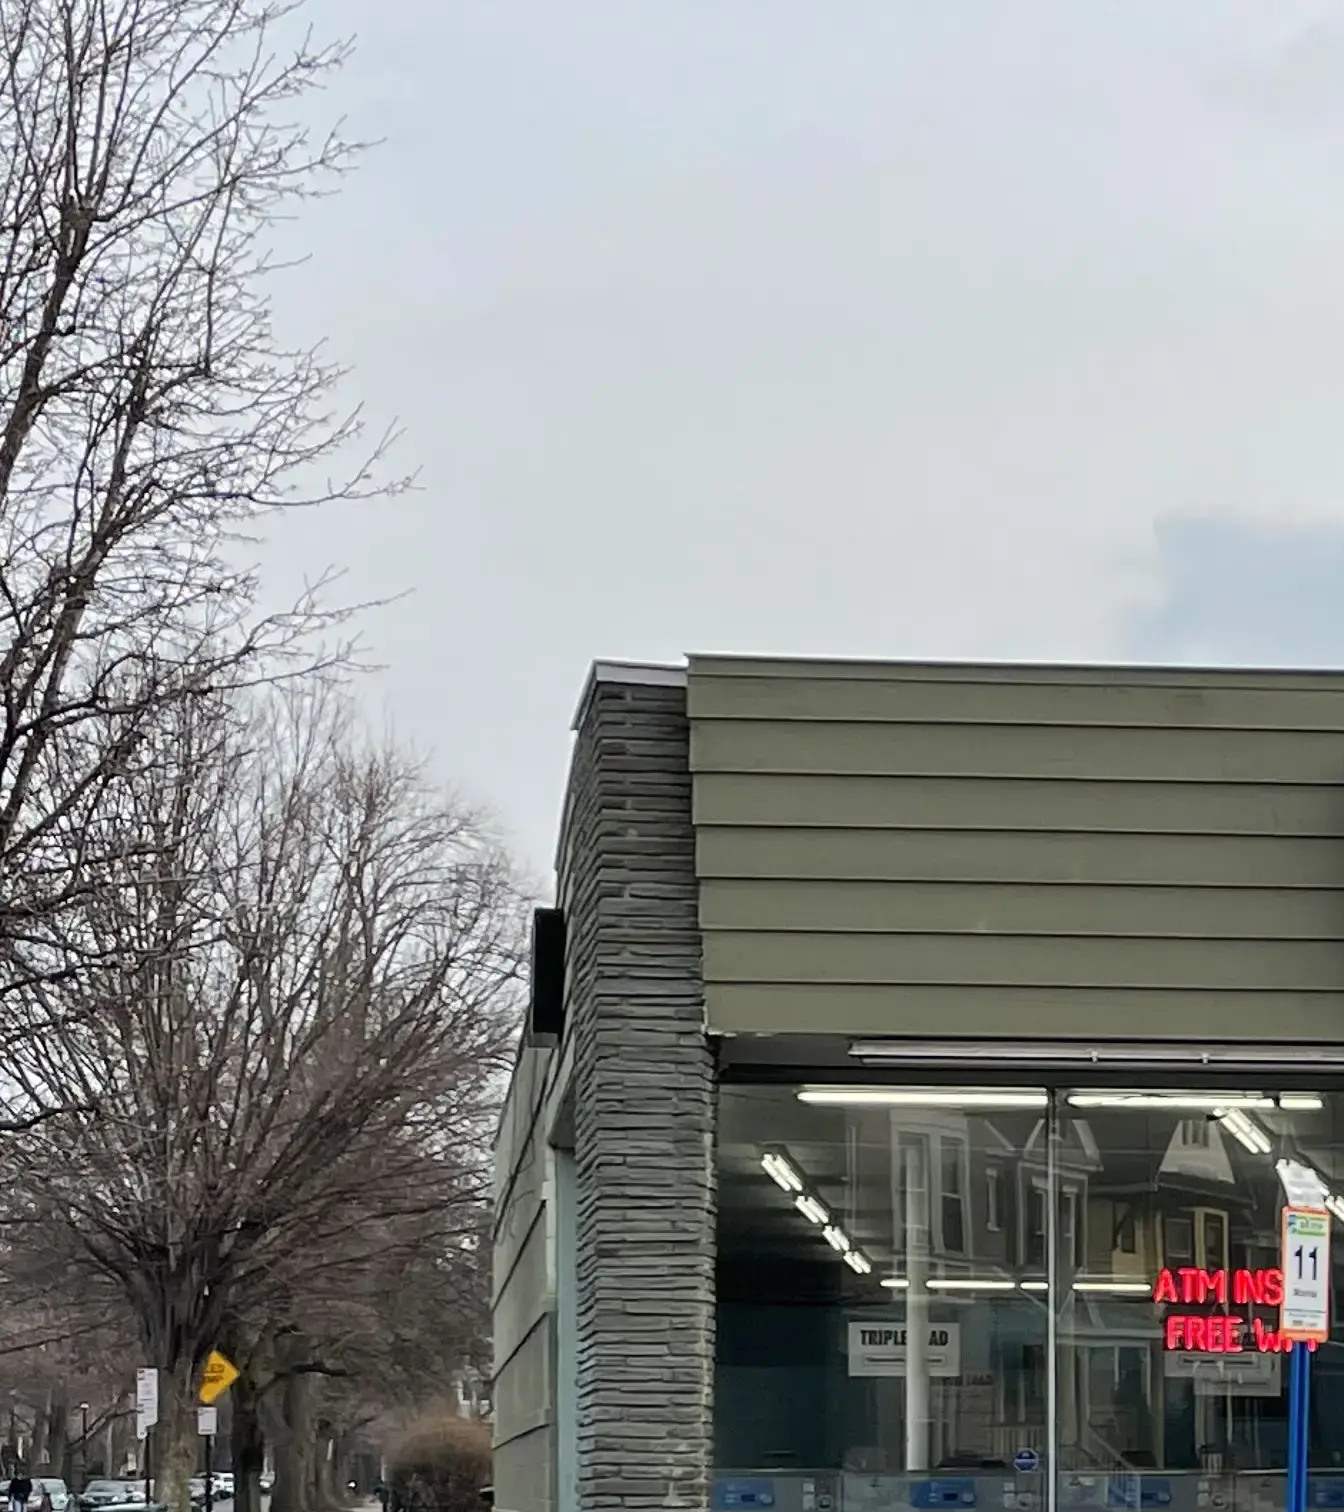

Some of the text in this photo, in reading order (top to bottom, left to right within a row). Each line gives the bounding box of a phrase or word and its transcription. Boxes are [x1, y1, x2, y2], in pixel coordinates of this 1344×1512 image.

[1294, 1245, 1318, 1281] 11
[1154, 1268, 1284, 1306] ATM INS
[1166, 1315, 1244, 1353] FREE
